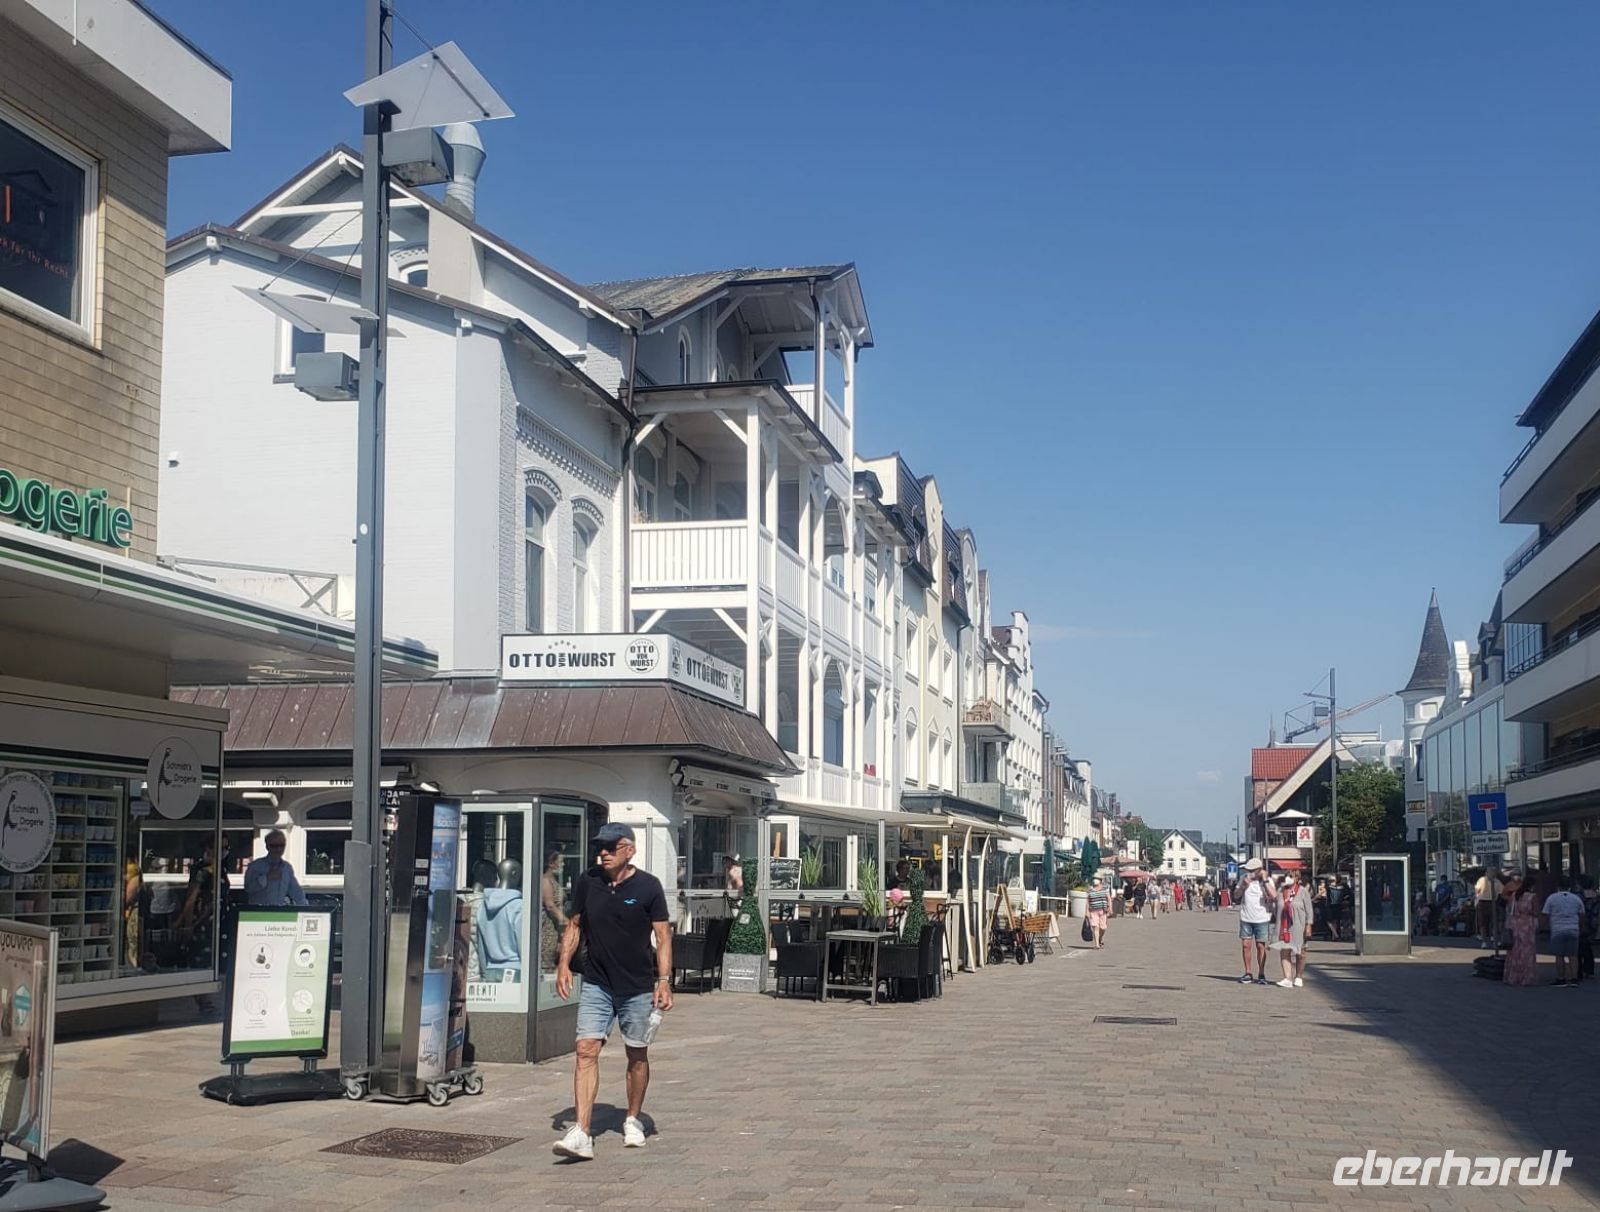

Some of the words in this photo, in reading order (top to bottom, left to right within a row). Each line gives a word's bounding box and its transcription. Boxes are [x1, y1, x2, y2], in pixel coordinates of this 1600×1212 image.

[630, 645, 655, 654] OTTO
[509, 652, 557, 668] OTTO
[567, 652, 616, 668] WURST
[630, 659, 654, 667] WURST
[687, 657, 707, 682] OTTO
[174, 773, 197, 784] Drogerie
[19, 816, 44, 828] Drogerie
